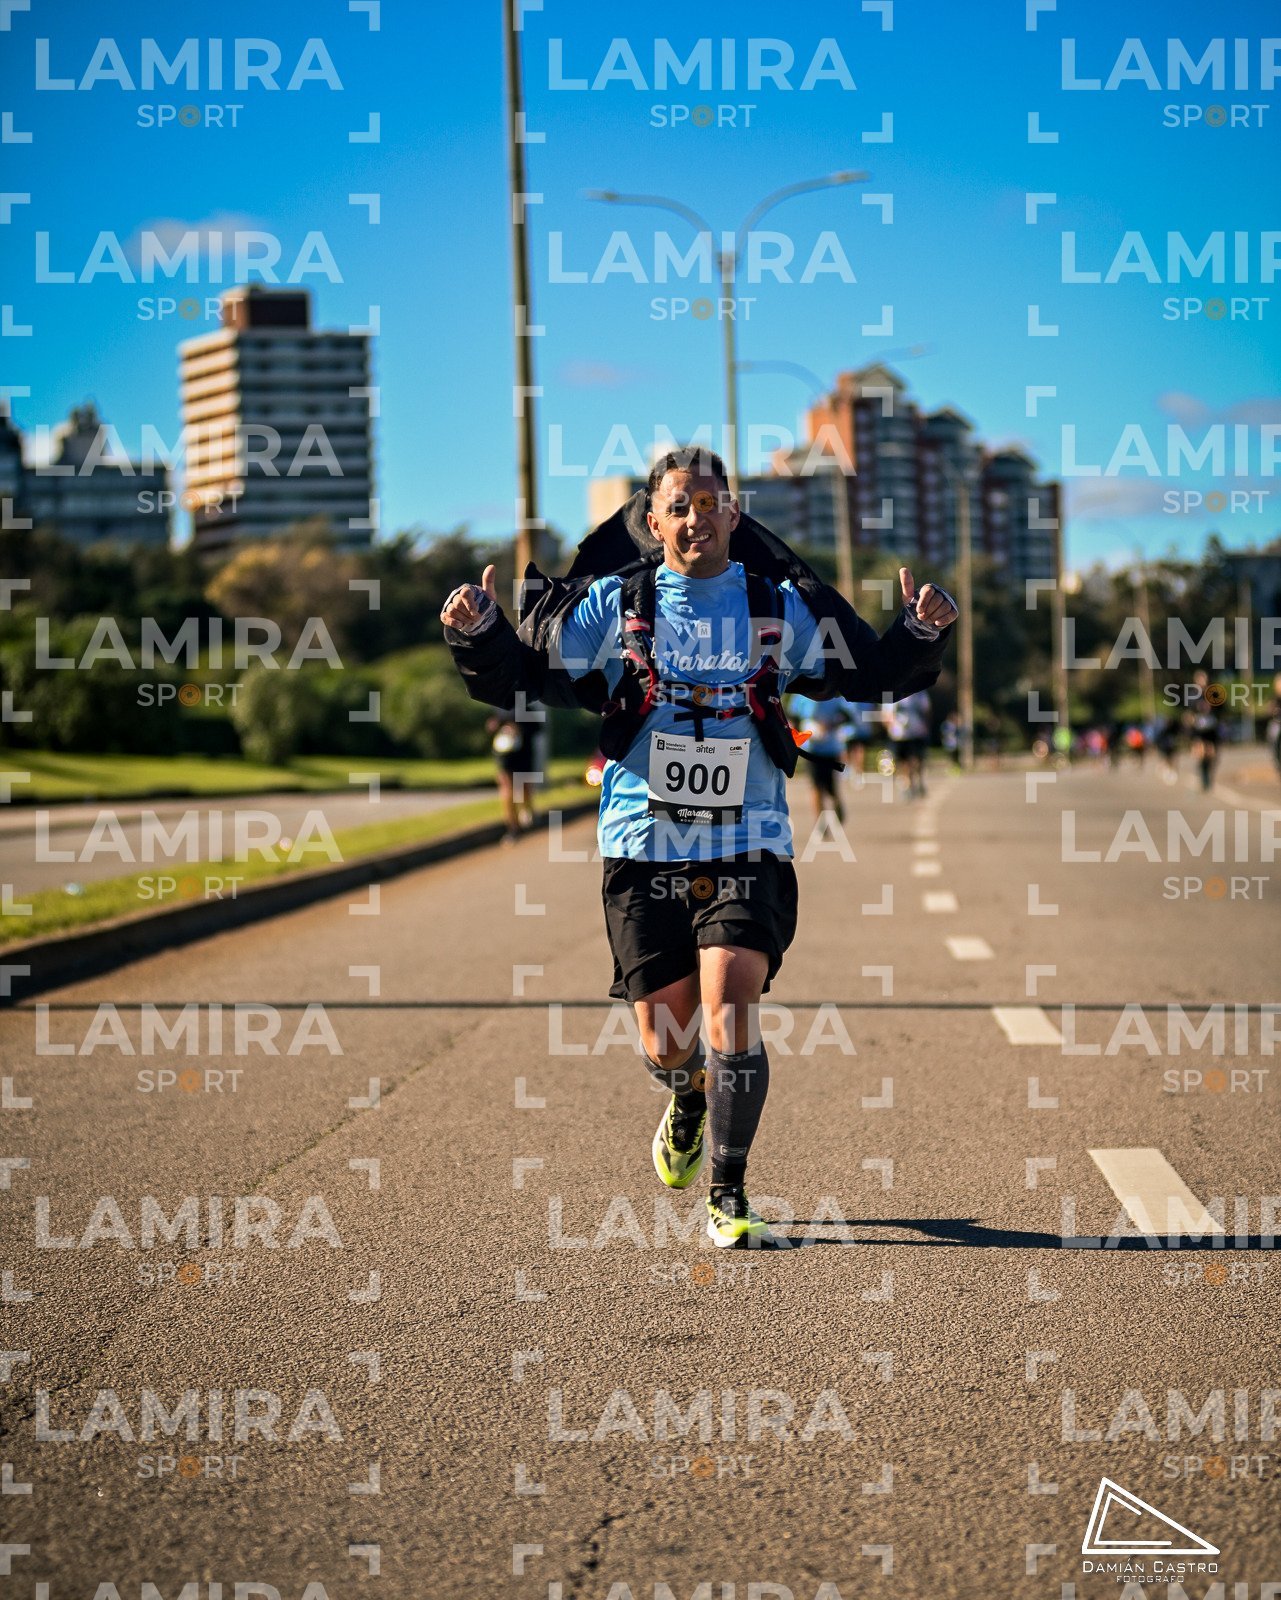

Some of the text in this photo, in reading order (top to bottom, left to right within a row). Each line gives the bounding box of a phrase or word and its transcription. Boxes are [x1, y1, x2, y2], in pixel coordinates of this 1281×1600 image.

[696, 745, 716, 754] antel
[665, 761, 730, 796] 900
[677, 808, 714, 820] Maratón
